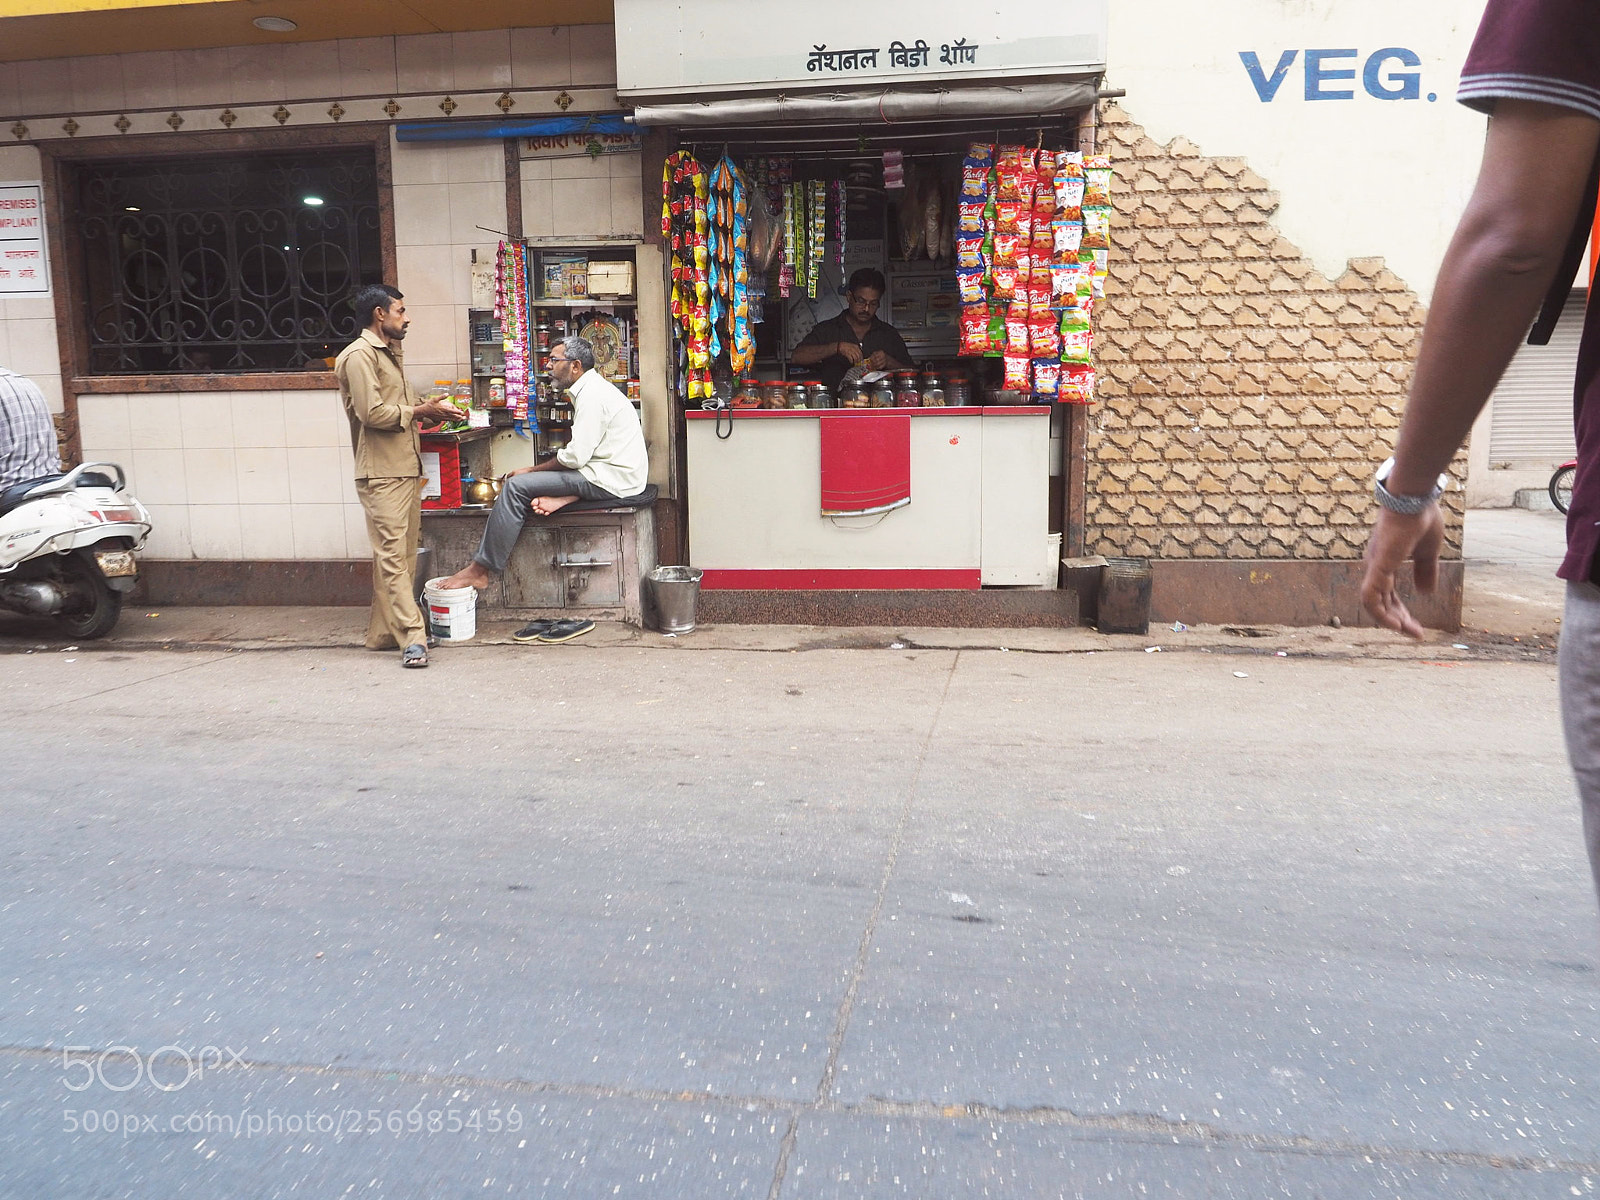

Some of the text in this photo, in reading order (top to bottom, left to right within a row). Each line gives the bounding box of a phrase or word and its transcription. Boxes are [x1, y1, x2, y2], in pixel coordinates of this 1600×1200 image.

[807, 37, 979, 72] नॅशनल बिडी शॉप
[1238, 47, 1437, 102] VEG.
